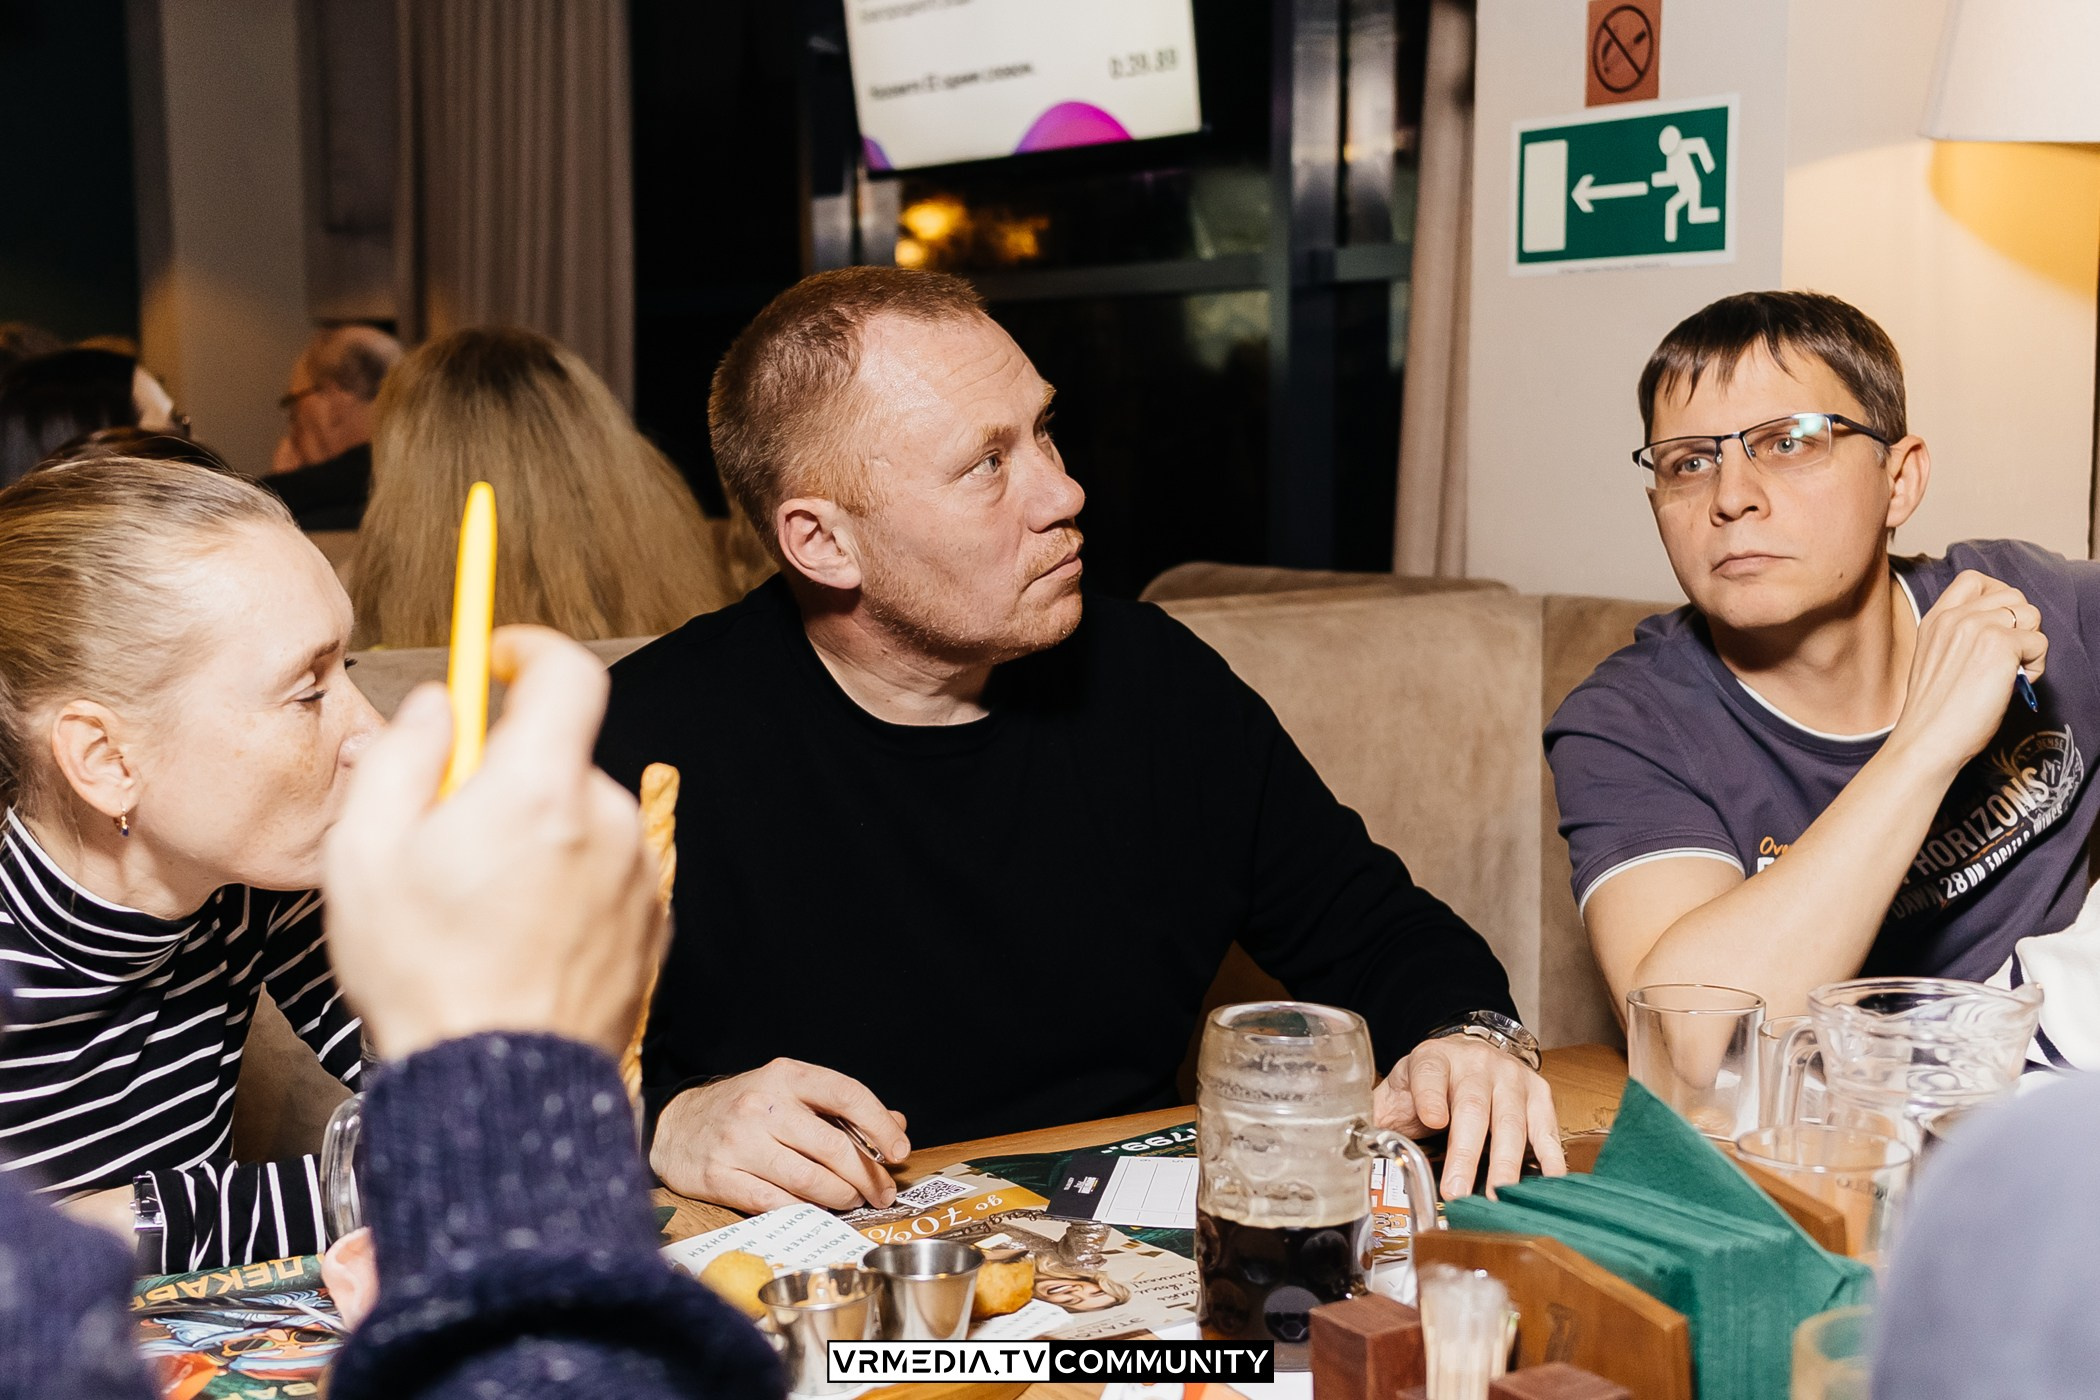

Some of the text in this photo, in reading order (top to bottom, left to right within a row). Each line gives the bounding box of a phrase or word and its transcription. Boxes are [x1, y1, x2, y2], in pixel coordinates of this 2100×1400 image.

[1913, 767, 2050, 876] HORIZONS
[1940, 870, 1968, 899] 28
[690, 1225, 741, 1258] МЮНХЕН
[867, 1206, 973, 1244] 70%
[801, 1233, 851, 1264] МЮНХЕН
